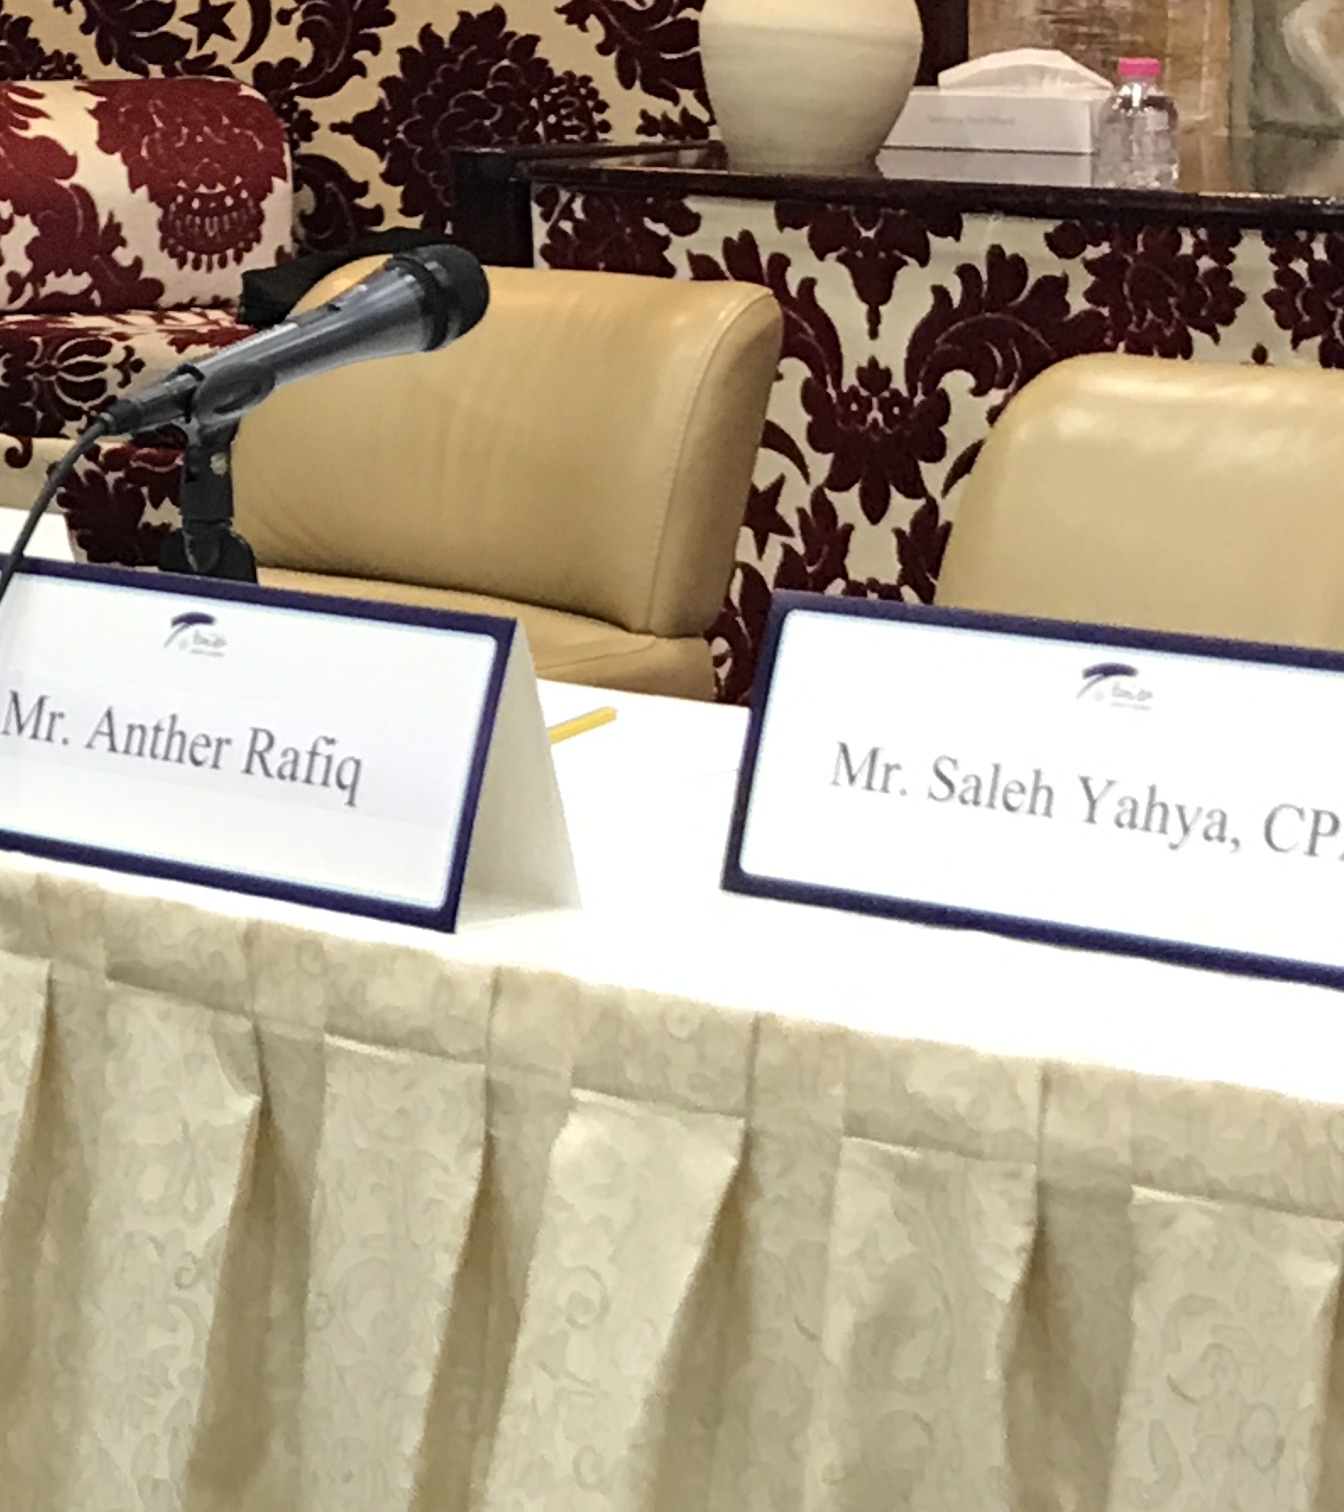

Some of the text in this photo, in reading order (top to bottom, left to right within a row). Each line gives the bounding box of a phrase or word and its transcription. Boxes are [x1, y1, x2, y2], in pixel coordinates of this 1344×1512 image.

[0, 689, 363, 808] Mr. Anther Rafiq
[831, 741, 1344, 862] Mr. Saleh Yahya, CP
